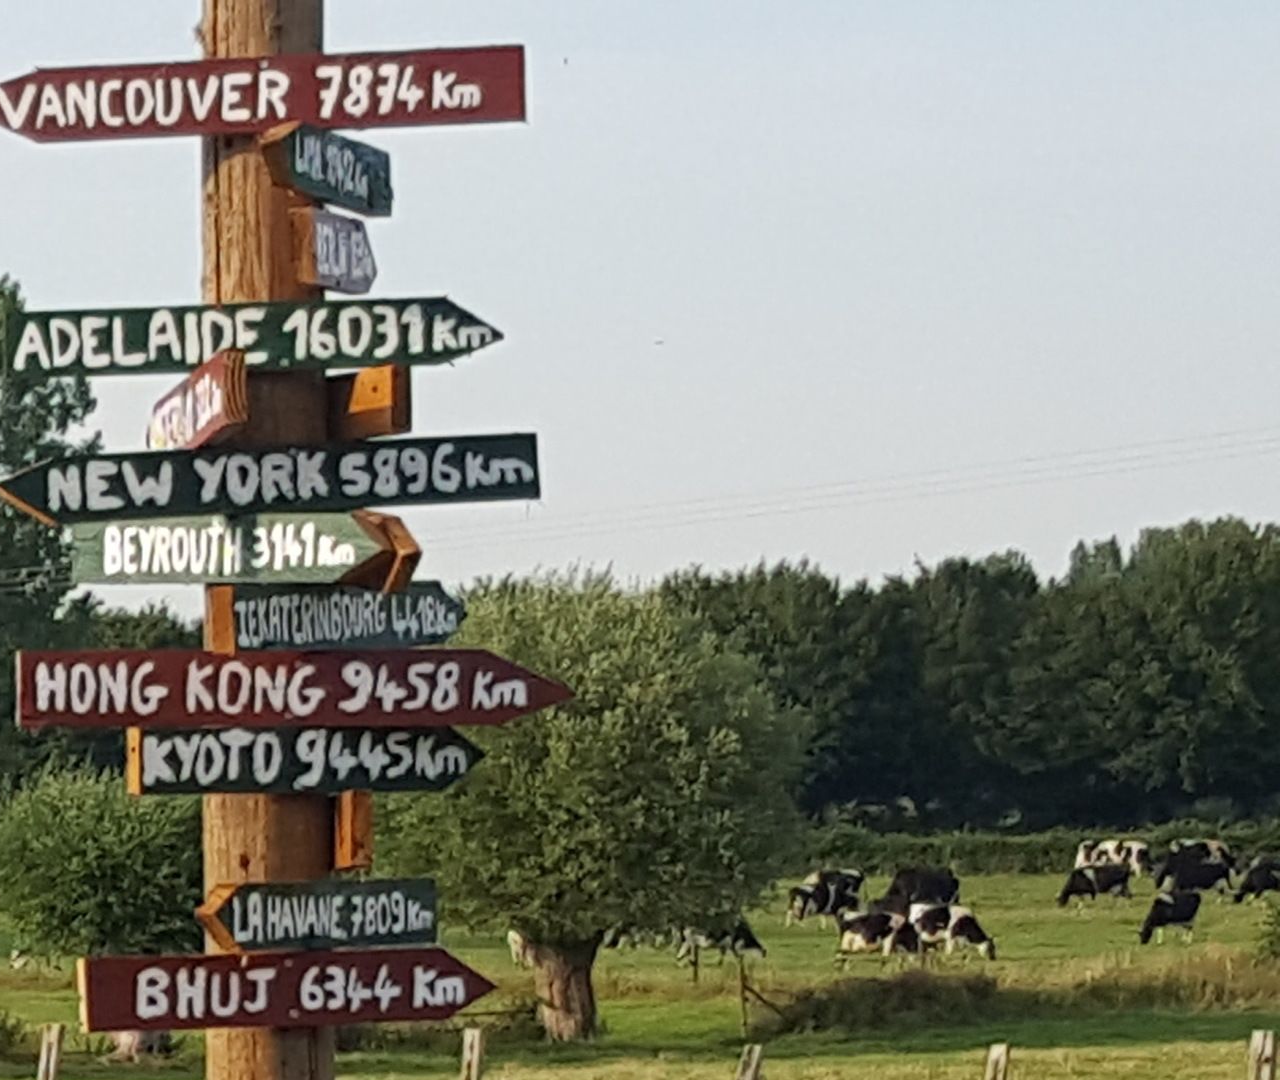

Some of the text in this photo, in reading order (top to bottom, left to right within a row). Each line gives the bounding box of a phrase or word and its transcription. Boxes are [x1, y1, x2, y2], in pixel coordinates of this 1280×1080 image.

[316, 63, 424, 119] 7874
[432, 70, 481, 110] Km
[13, 308, 268, 371] ADELAIDE
[282, 303, 424, 360] 16031
[47, 460, 173, 512] NEW
[193, 451, 329, 505] YORK
[340, 443, 461, 497] 5896
[103, 517, 242, 576] BEYROUTH
[251, 522, 315, 570] 3141
[35, 659, 528, 717] HONG KONG 9458 Km
[142, 728, 283, 787] KYOTO
[293, 728, 414, 790] 9445
[233, 892, 265, 943] LA
[267, 894, 348, 940] HAVANE
[351, 891, 405, 937] 7809
[136, 964, 467, 1019] BHUJ 6344 Km
